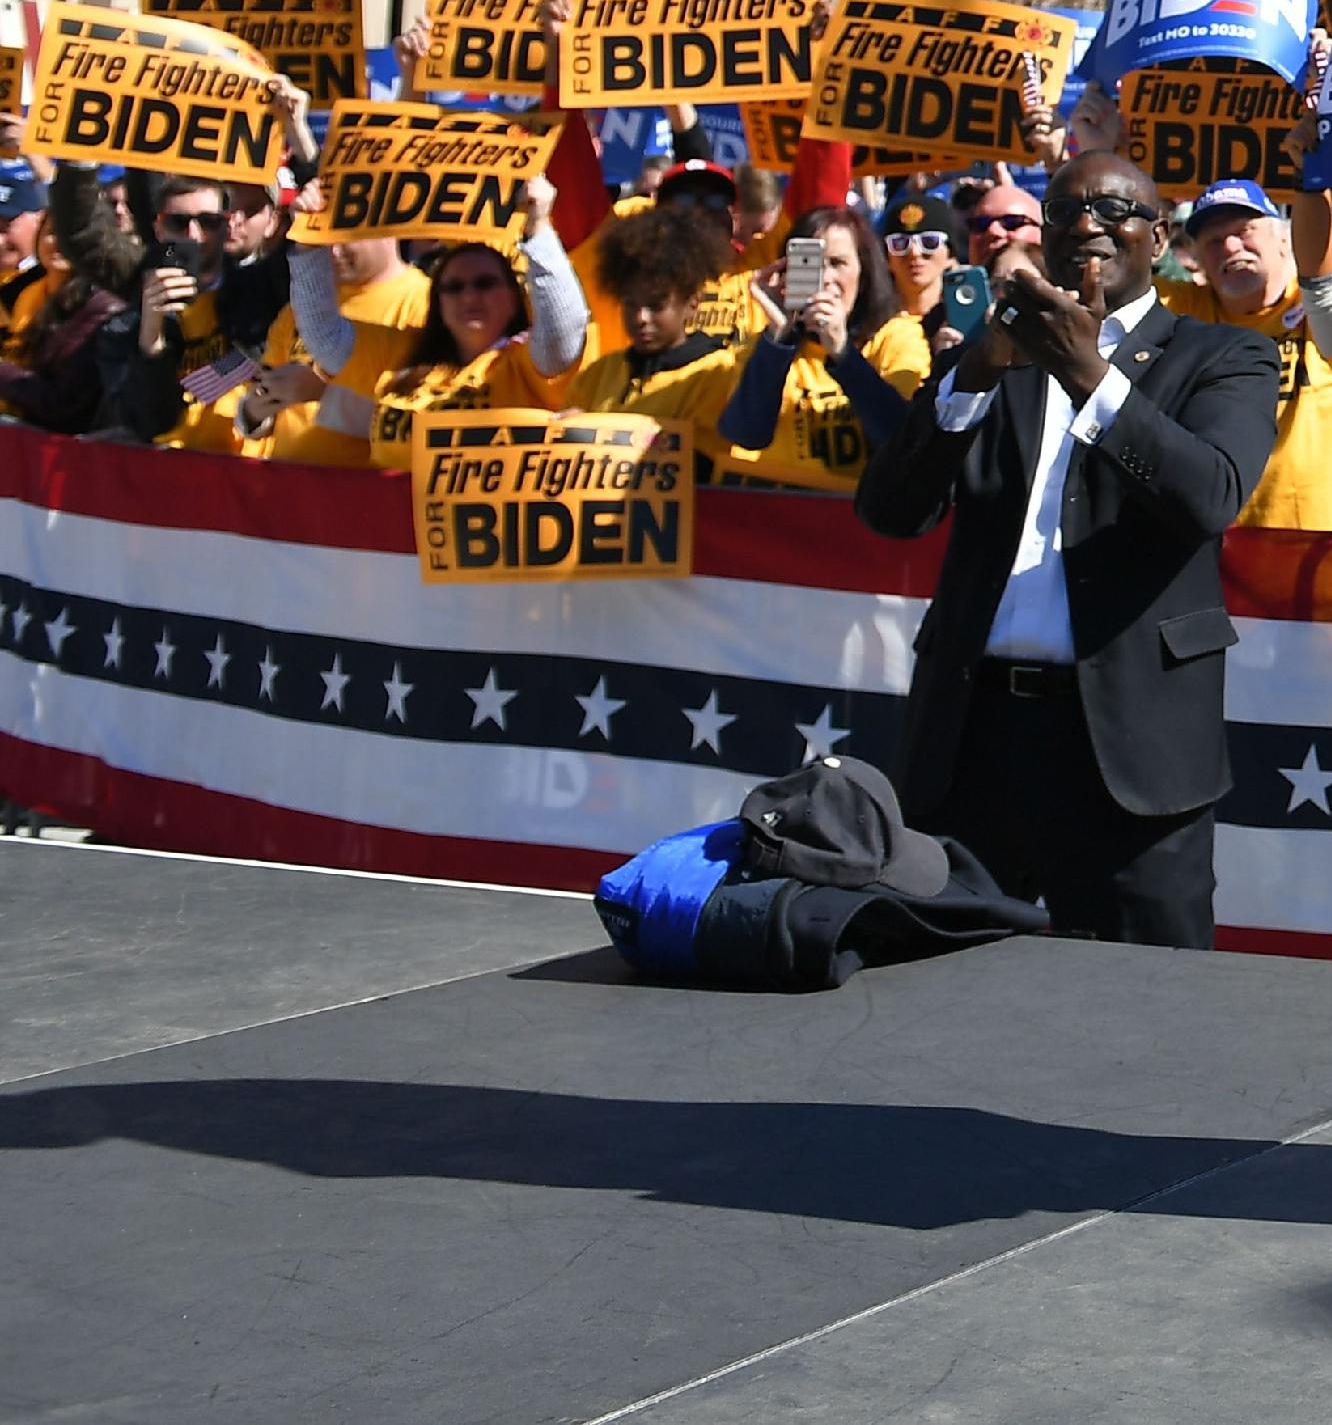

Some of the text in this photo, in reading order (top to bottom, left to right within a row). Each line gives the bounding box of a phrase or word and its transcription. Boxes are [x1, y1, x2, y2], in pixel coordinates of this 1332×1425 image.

[425, 21, 450, 79] FOR
[454, 27, 546, 81] BID
[572, 33, 592, 95] FOR
[602, 25, 813, 92] BIDEN
[833, 22, 903, 63] Fire
[52, 42, 127, 84] Fire
[134, 53, 275, 104] Fighters
[816, 61, 844, 126] FOR
[1131, 74, 1201, 115] Fire
[36, 83, 64, 143] FOR
[64, 88, 275, 169] BIDEN
[1128, 117, 1148, 163] OR
[327, 132, 538, 168] Fire Fighters
[1153, 121, 1298, 188] BIDE
[330, 172, 526, 230] BIDEN
[426, 450, 680, 499] Fire Fighters
[426, 501, 448, 571] FOR
[452, 501, 680, 567] BIDEN
